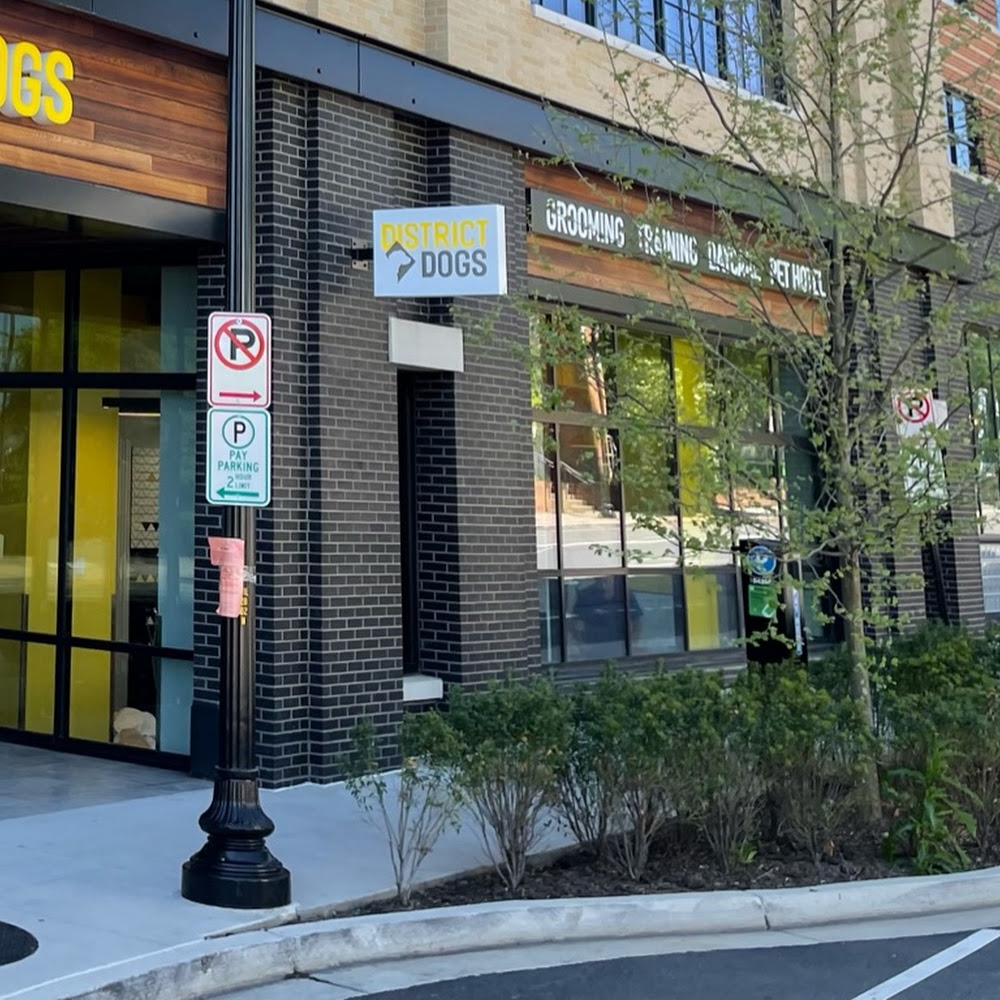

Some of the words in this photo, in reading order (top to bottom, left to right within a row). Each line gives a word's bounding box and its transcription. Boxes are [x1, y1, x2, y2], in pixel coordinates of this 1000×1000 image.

[380, 218, 488, 250] DISTRICT
[545, 197, 625, 248] GROOMING
[769, 256, 790, 288] PET
[421, 249, 488, 279] DOGS
[234, 421, 246, 444] P
[217, 461, 259, 473] PARKING
[229, 450, 248, 461] PAY
[226, 475, 235, 489] 2
